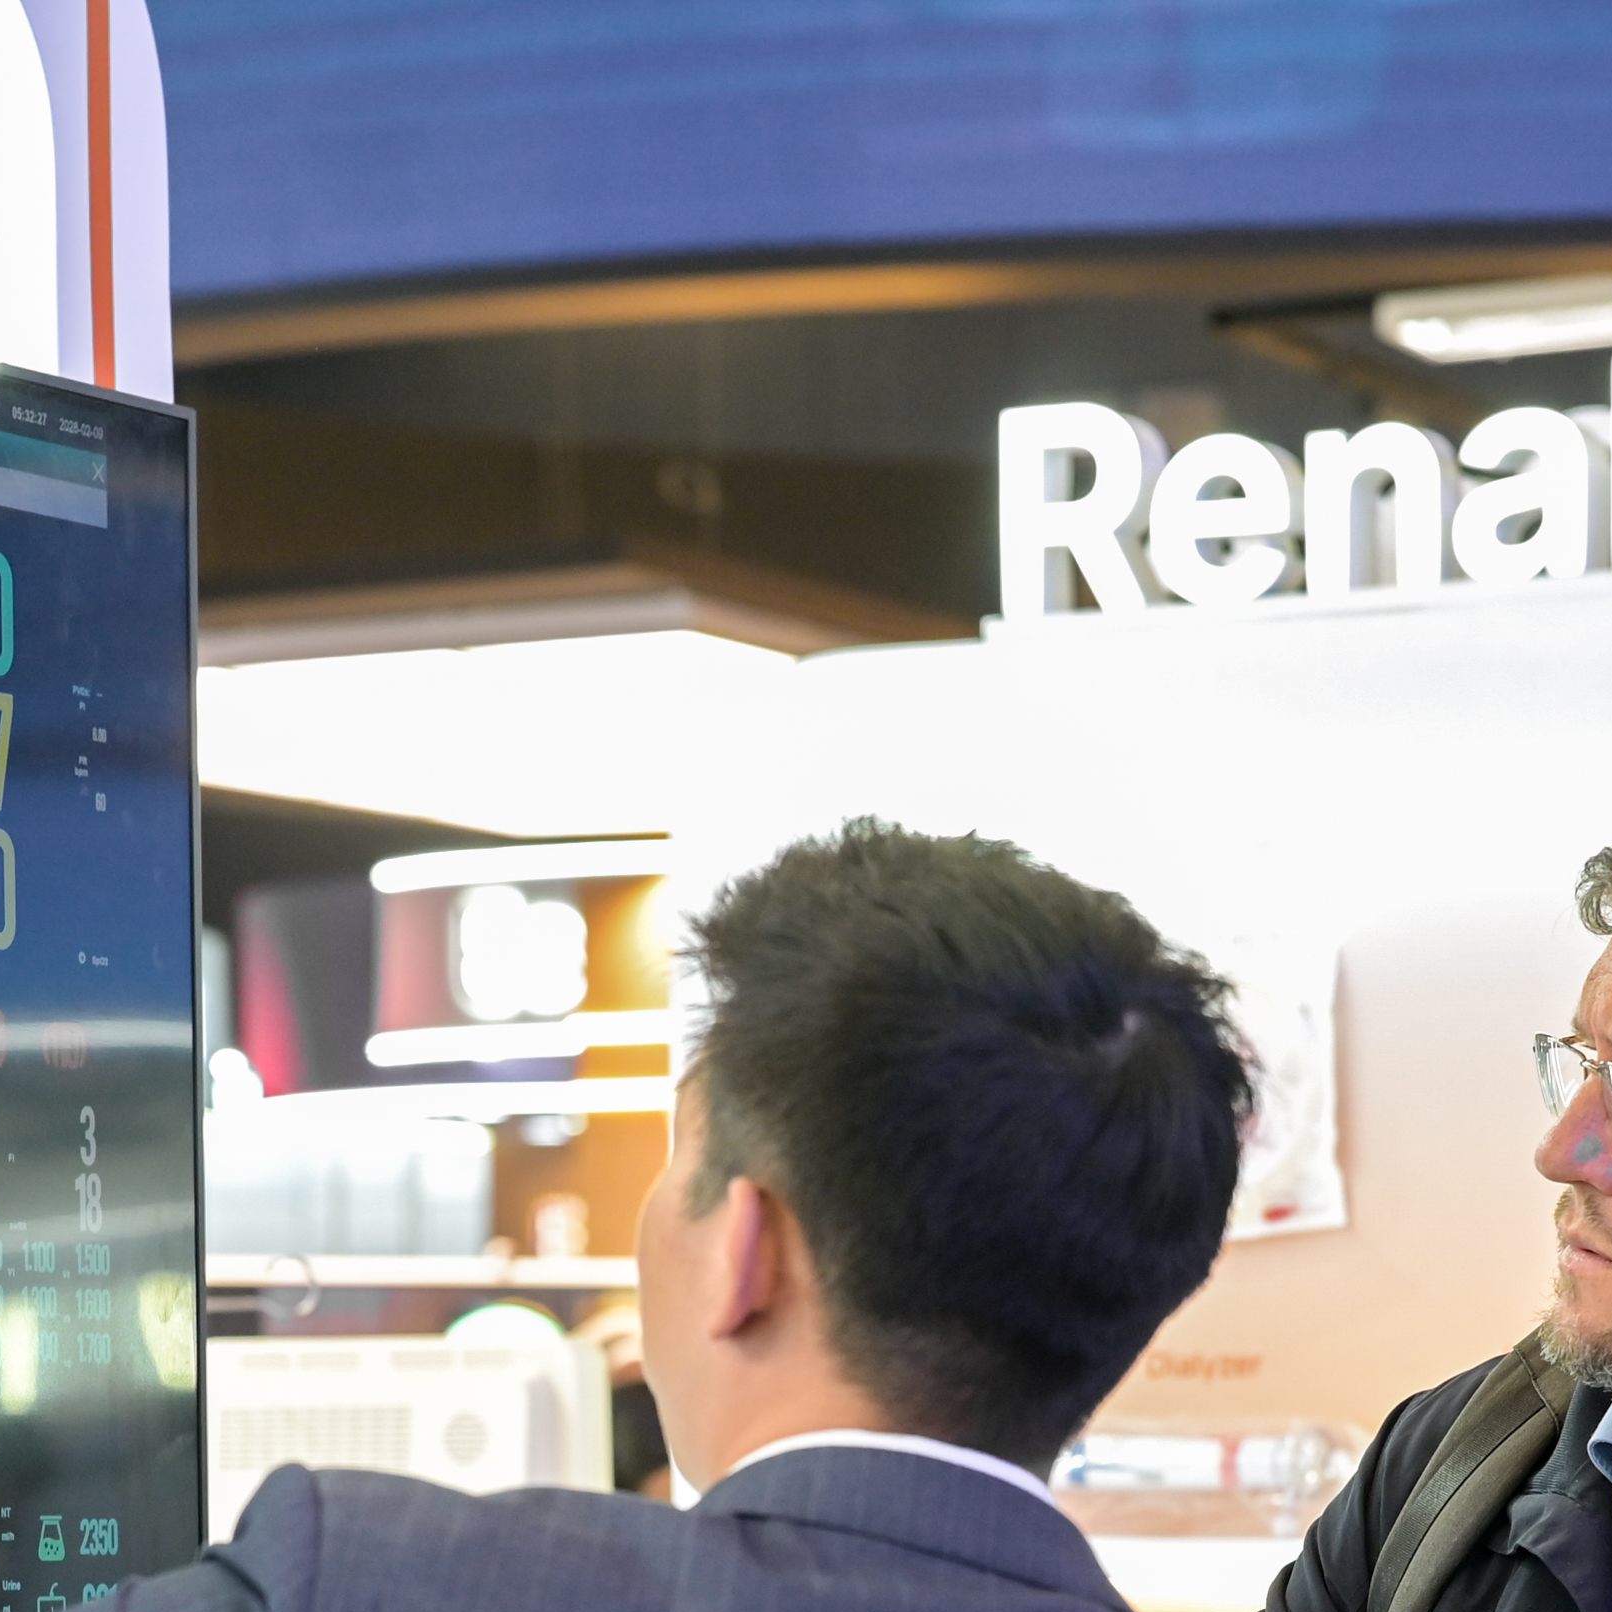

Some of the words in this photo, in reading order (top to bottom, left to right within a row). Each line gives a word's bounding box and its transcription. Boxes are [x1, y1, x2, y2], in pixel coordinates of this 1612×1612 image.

[11, 405, 47, 426] 05:32:27
[80, 1105, 97, 1166] 3
[74, 1172, 103, 1234] 18
[1147, 1350, 1264, 1383] Dialyzer
[79, 1518, 119, 1556] 2350
[2, 1580, 21, 1592] Urine
